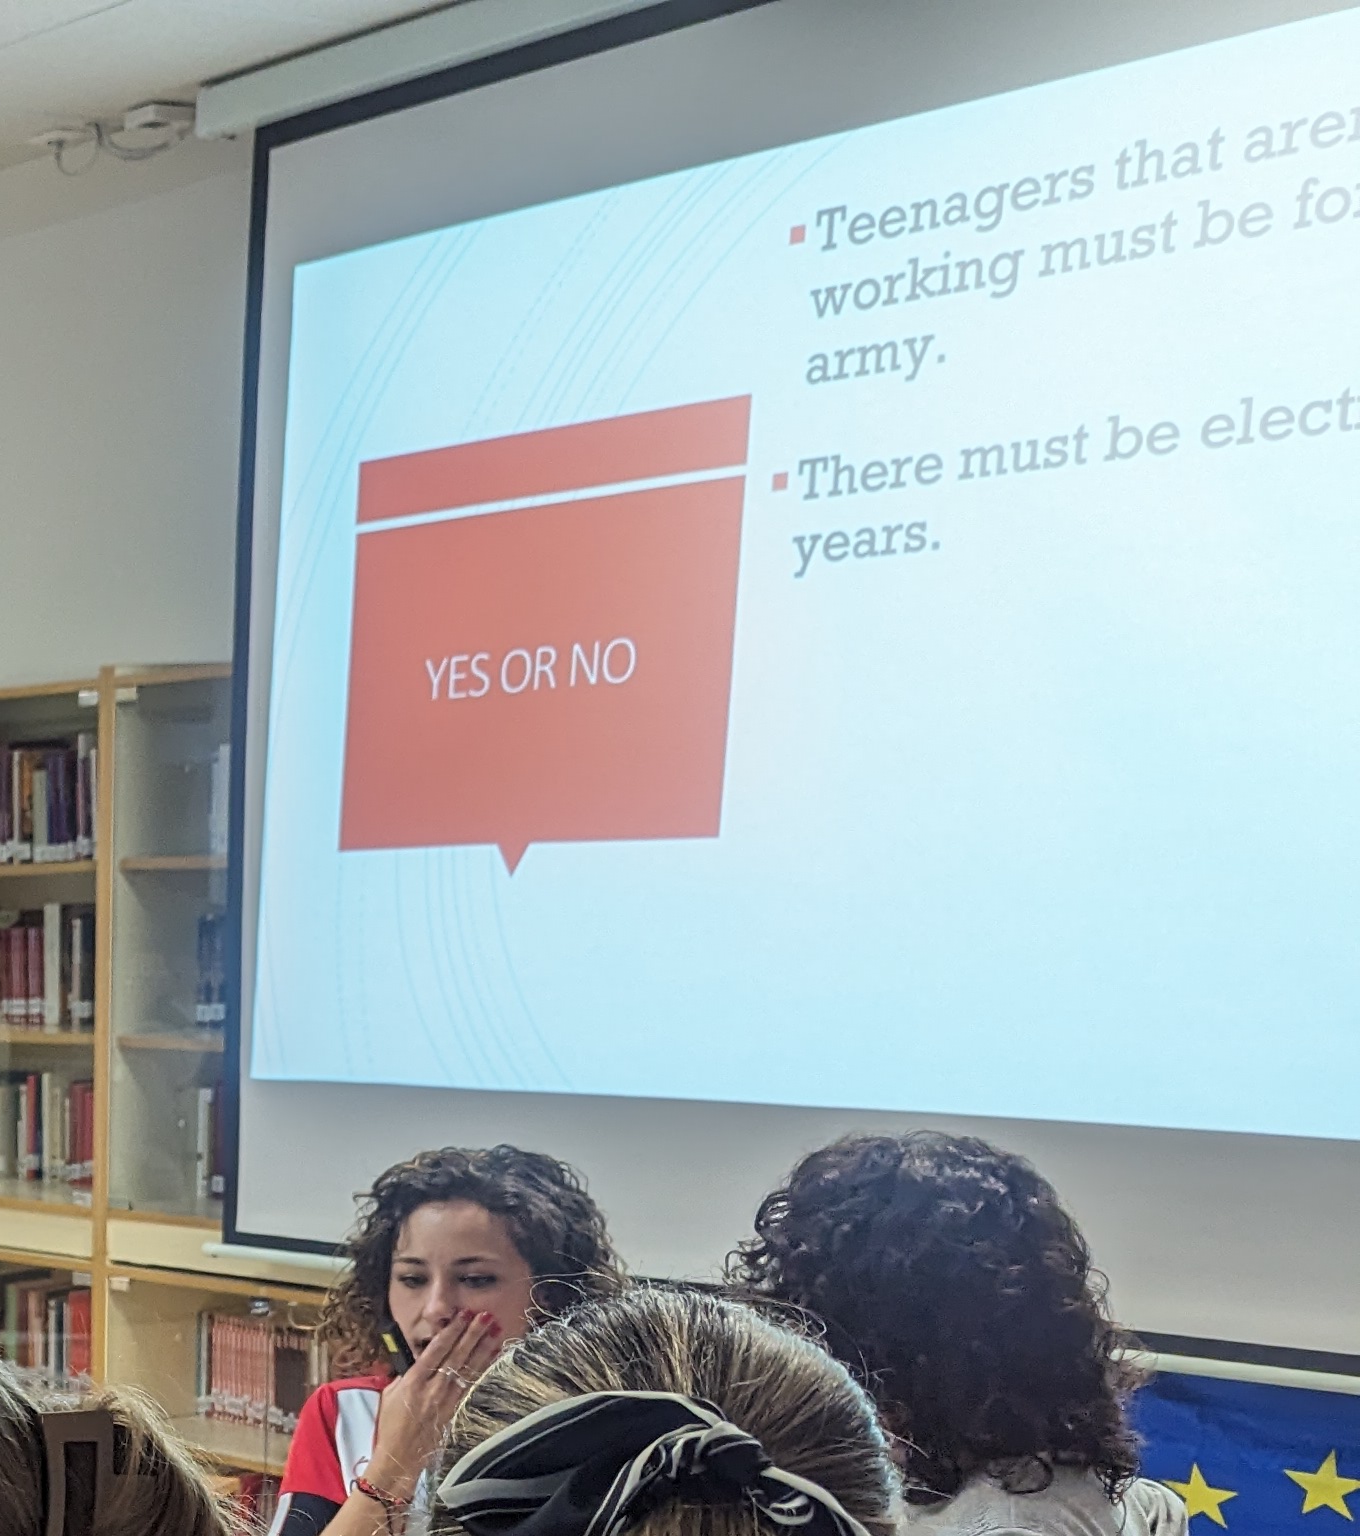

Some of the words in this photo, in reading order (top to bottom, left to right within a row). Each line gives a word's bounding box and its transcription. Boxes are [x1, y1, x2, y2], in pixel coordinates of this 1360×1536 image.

[815, 164, 1095, 252] Teenagers
[1114, 126, 1226, 191] that
[810, 249, 1025, 319] working
[1037, 209, 1178, 278] must
[1192, 199, 1274, 249] be
[1293, 176, 1360, 230] fo
[805, 333, 947, 385] army.
[797, 451, 944, 501] There
[956, 423, 1090, 481] must
[1102, 414, 1181, 463] be
[1199, 386, 1360, 449] elect
[791, 520, 942, 580] years.
[424, 651, 491, 701] YES
[500, 644, 557, 694] OR
[569, 636, 638, 687] NO
